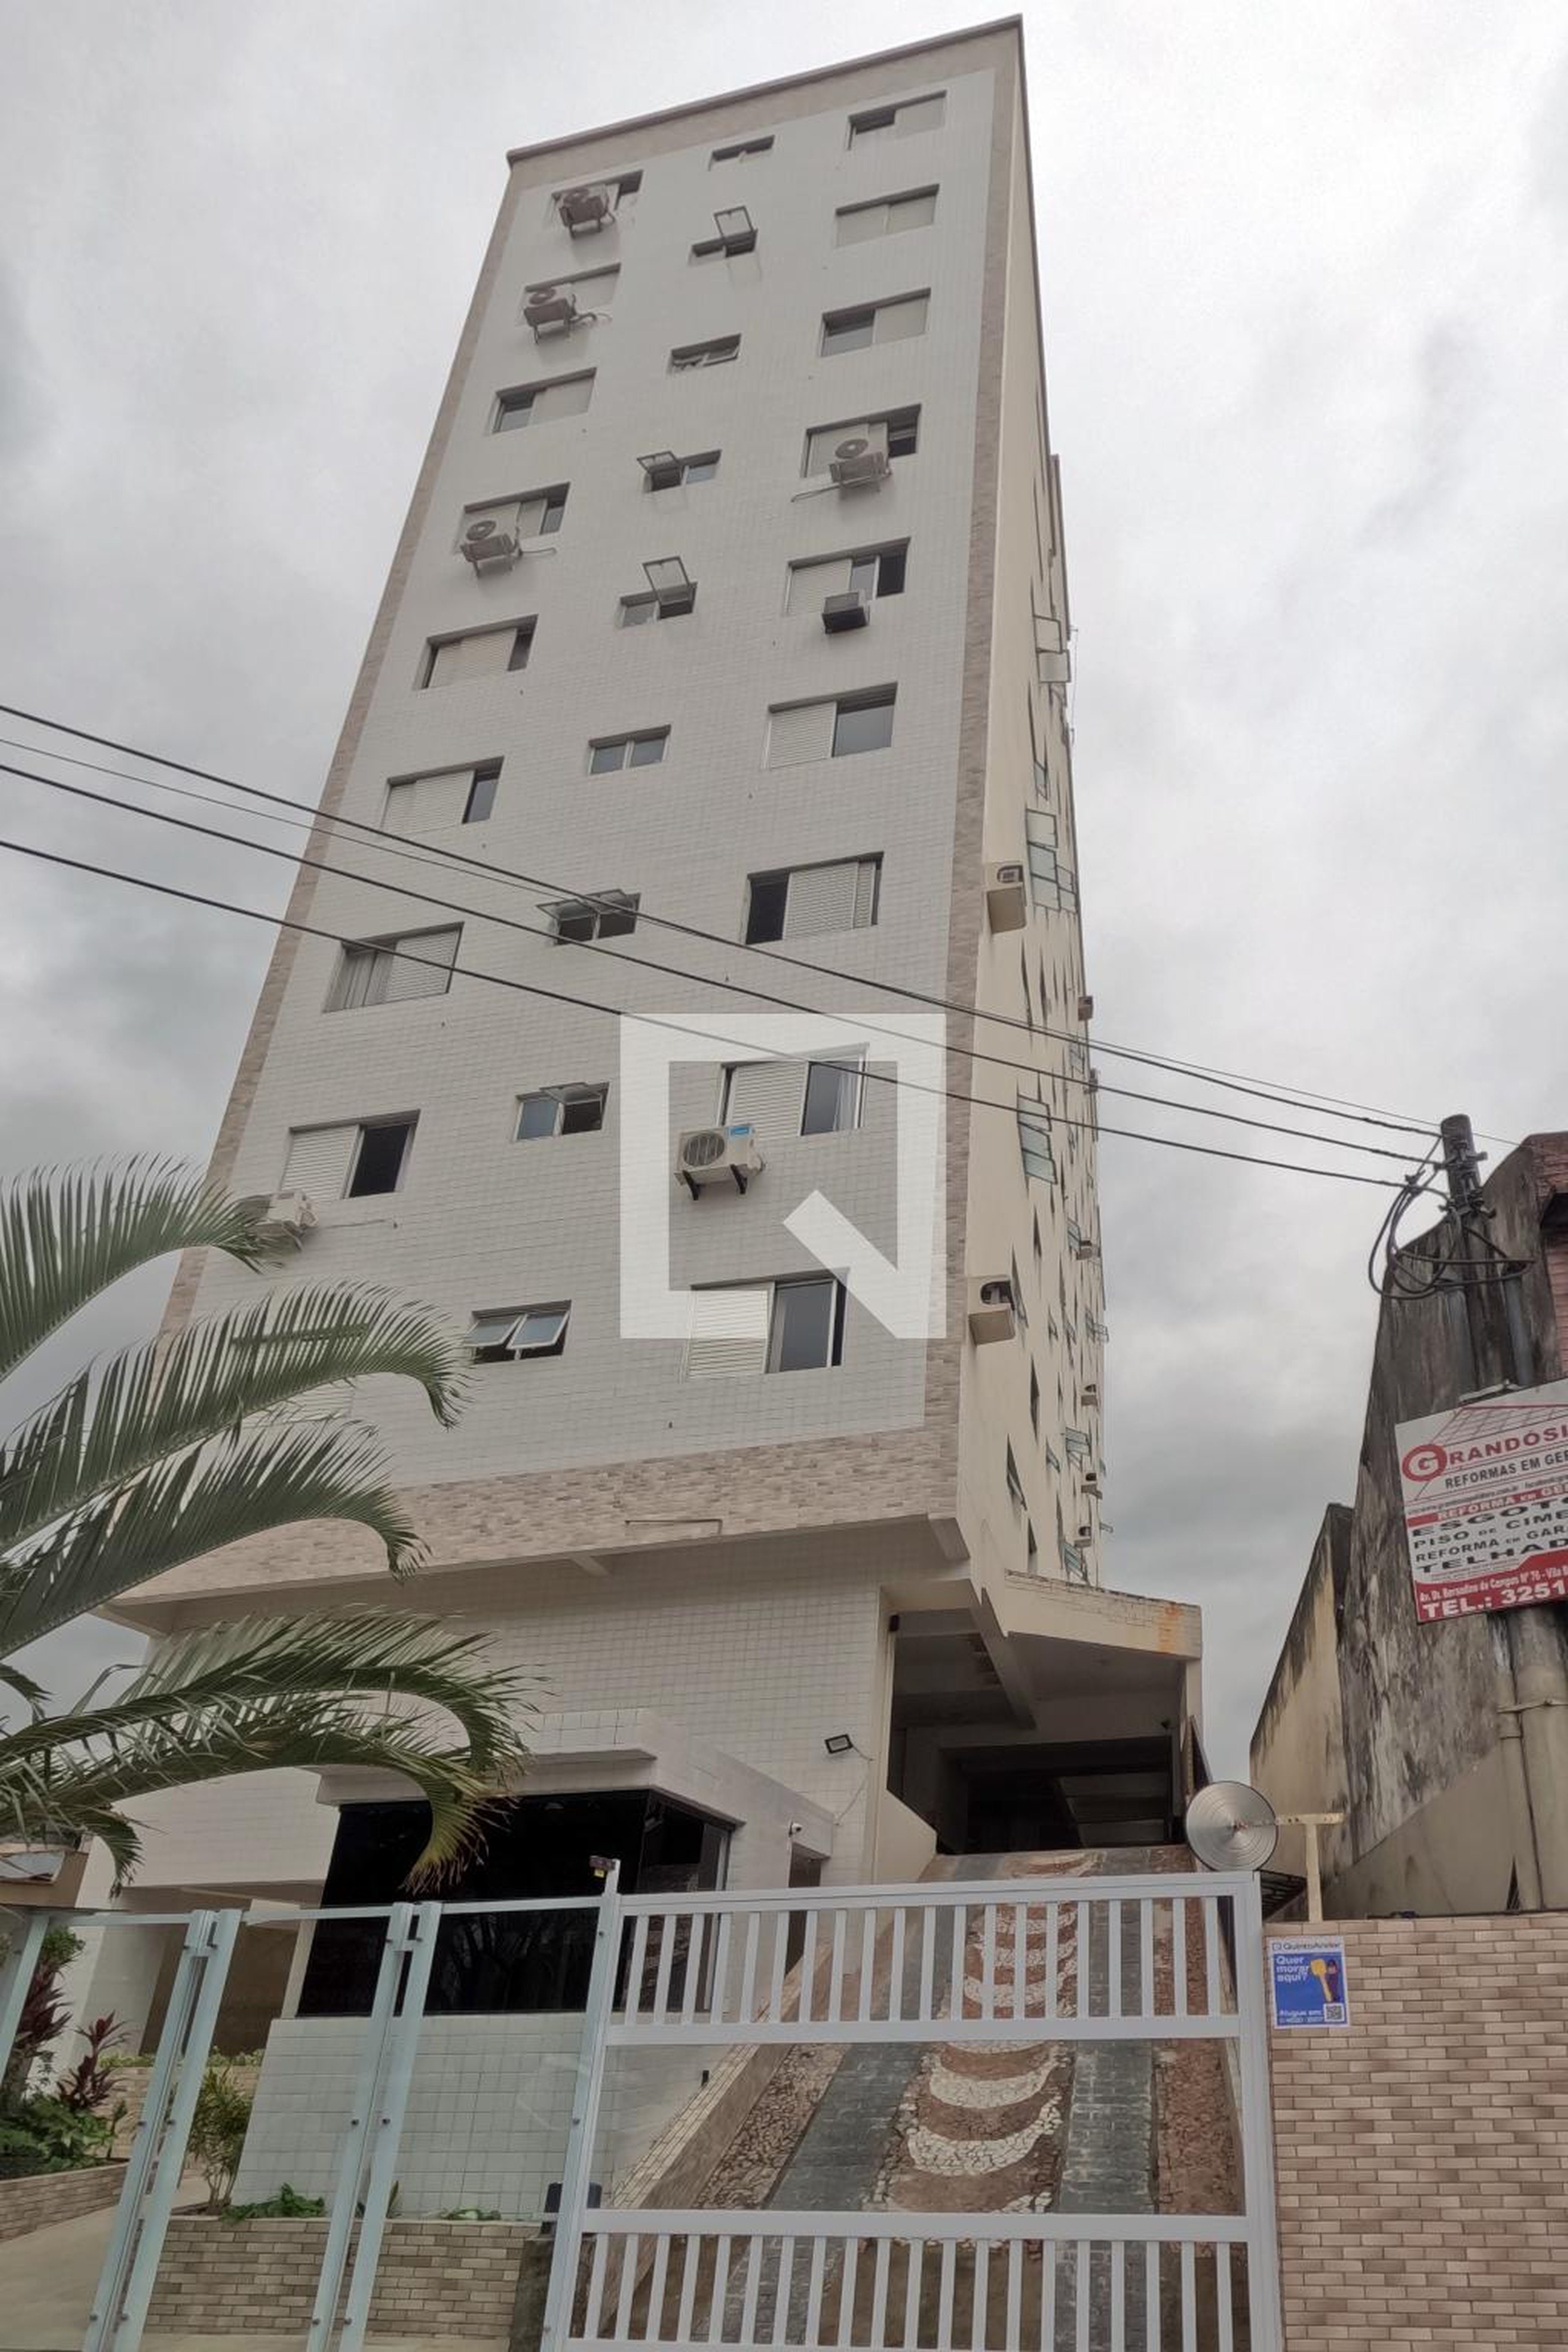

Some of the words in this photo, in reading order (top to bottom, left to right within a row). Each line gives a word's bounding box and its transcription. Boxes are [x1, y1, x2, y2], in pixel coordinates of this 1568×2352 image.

[1445, 1463, 1516, 1489] REFORMAS
[1521, 1457, 1541, 1470] EM
[1412, 1496, 1568, 1537] ESGOT
[1438, 1496, 1515, 1520] REFORMA
[1414, 1531, 1469, 1549] PISO
[1416, 1539, 1499, 1562] REFORMA
[1422, 1596, 1492, 1618] TEL.:
[1501, 1579, 1566, 1604] 3251
[1276, 1956, 1304, 1965] Quer
